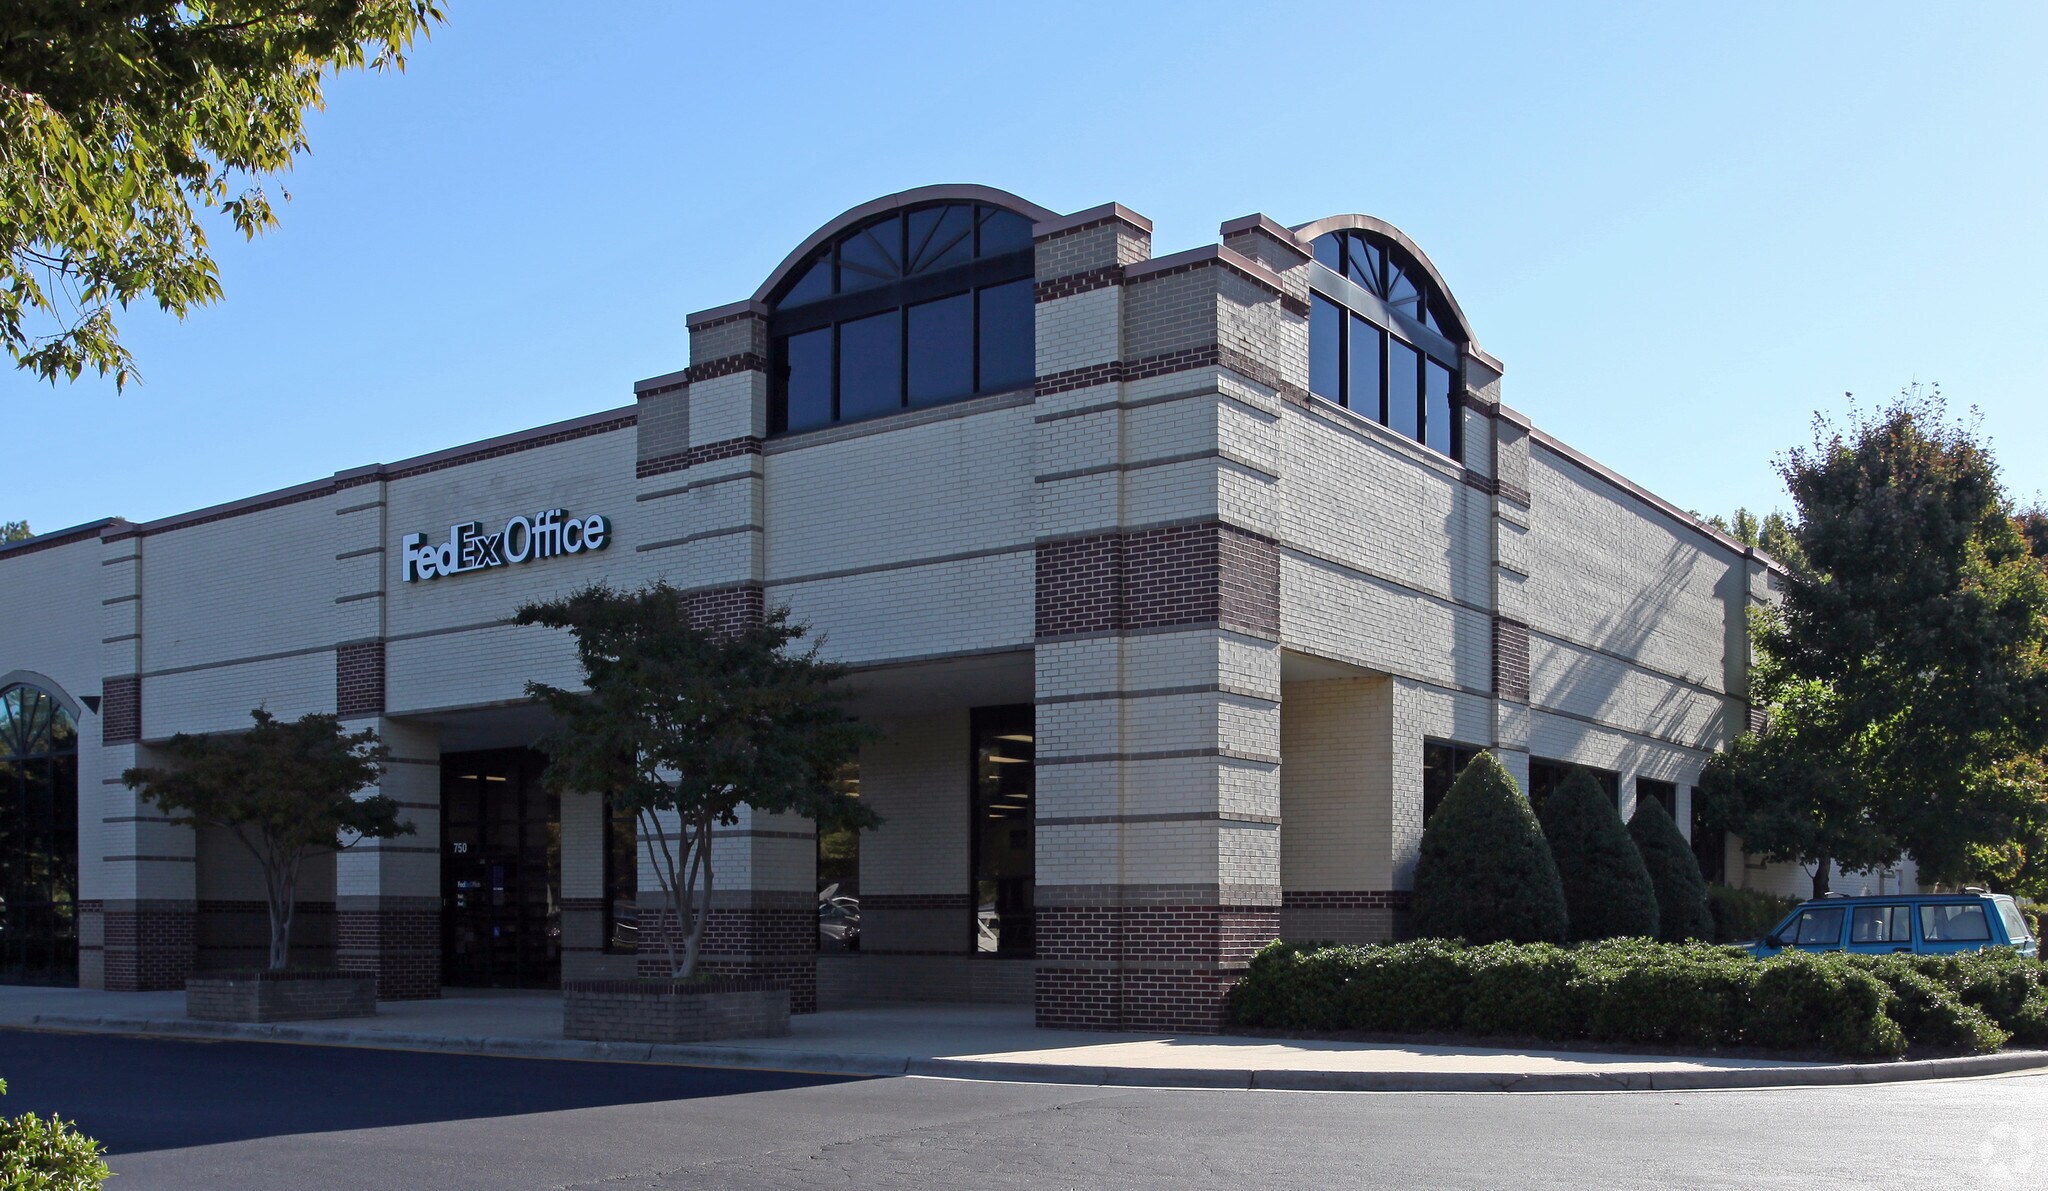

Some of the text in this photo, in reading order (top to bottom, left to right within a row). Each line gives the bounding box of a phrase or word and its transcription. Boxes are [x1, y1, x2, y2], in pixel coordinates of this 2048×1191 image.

[402, 508, 607, 582] FedEx Office
[453, 842, 468, 853] 750
